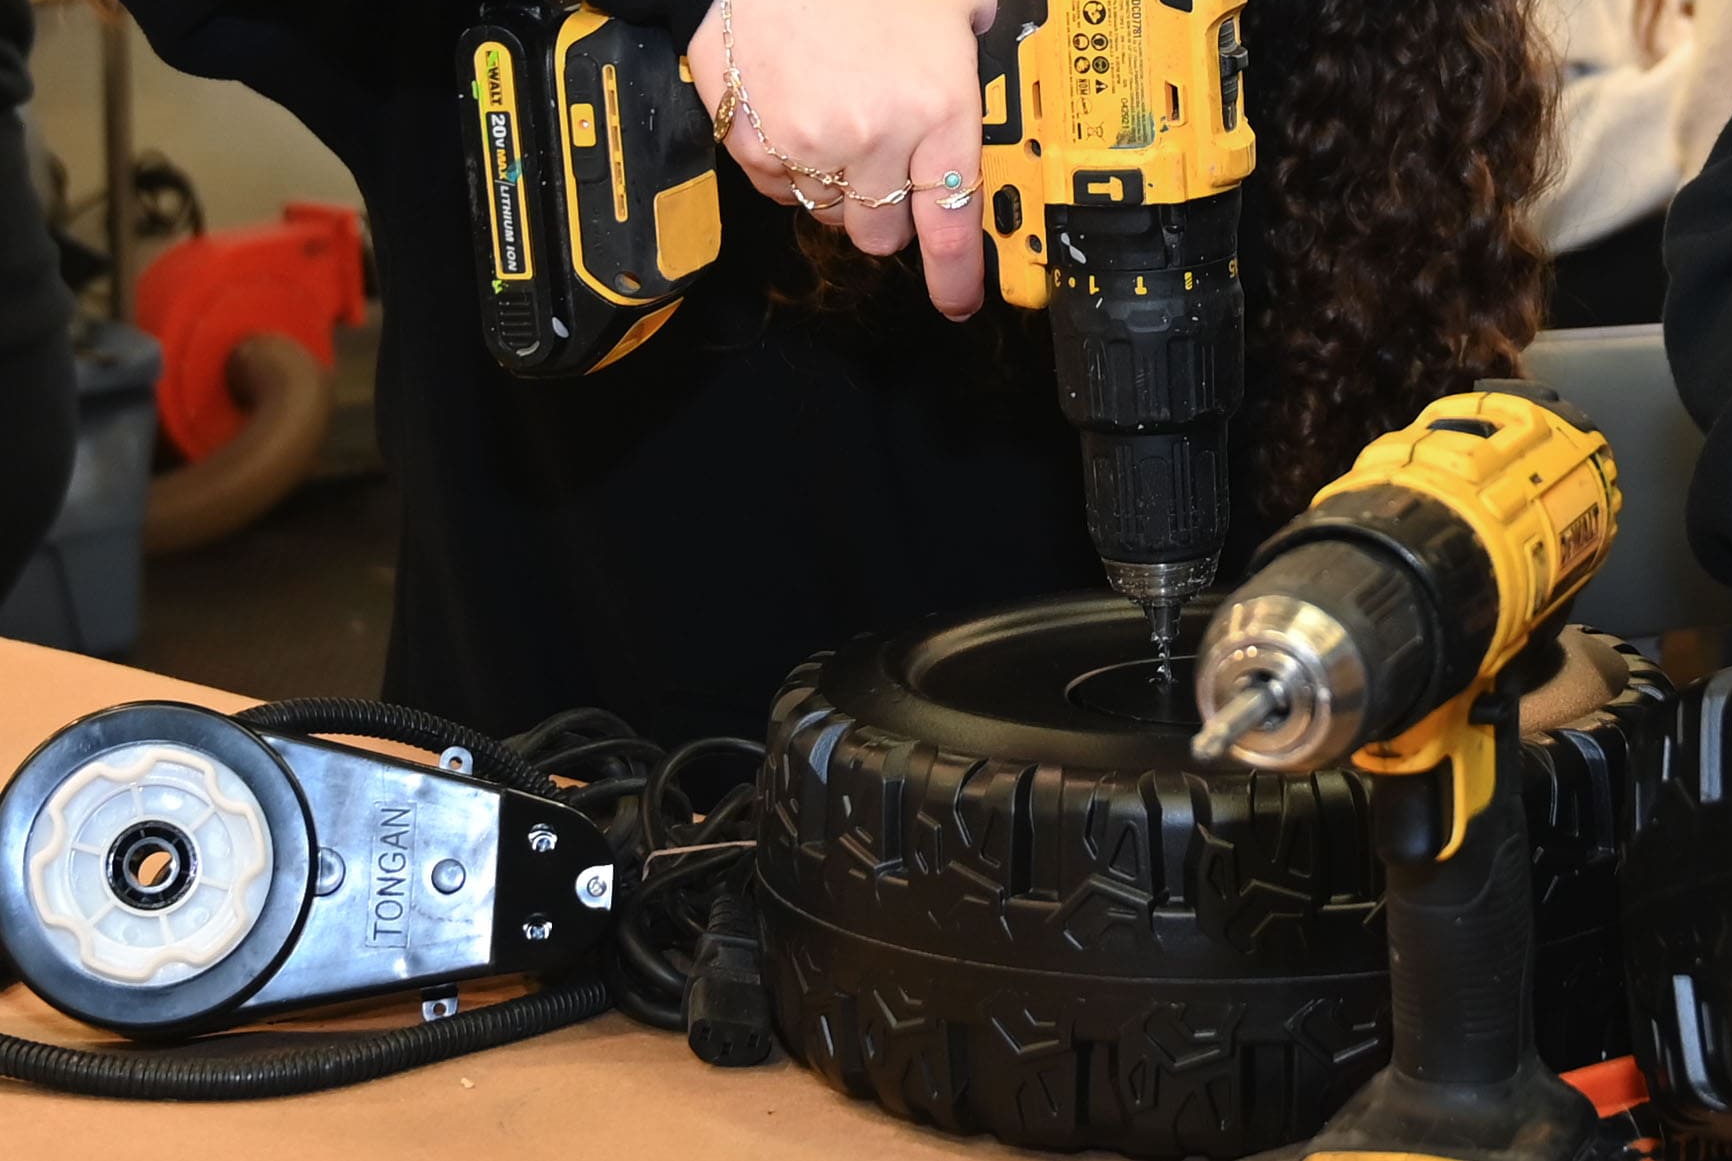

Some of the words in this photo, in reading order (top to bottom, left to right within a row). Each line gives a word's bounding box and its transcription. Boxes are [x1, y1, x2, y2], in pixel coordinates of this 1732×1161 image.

[500, 184, 515, 243] LITHIUM
[506, 245, 518, 271] ION
[373, 808, 411, 941] TONGAN
